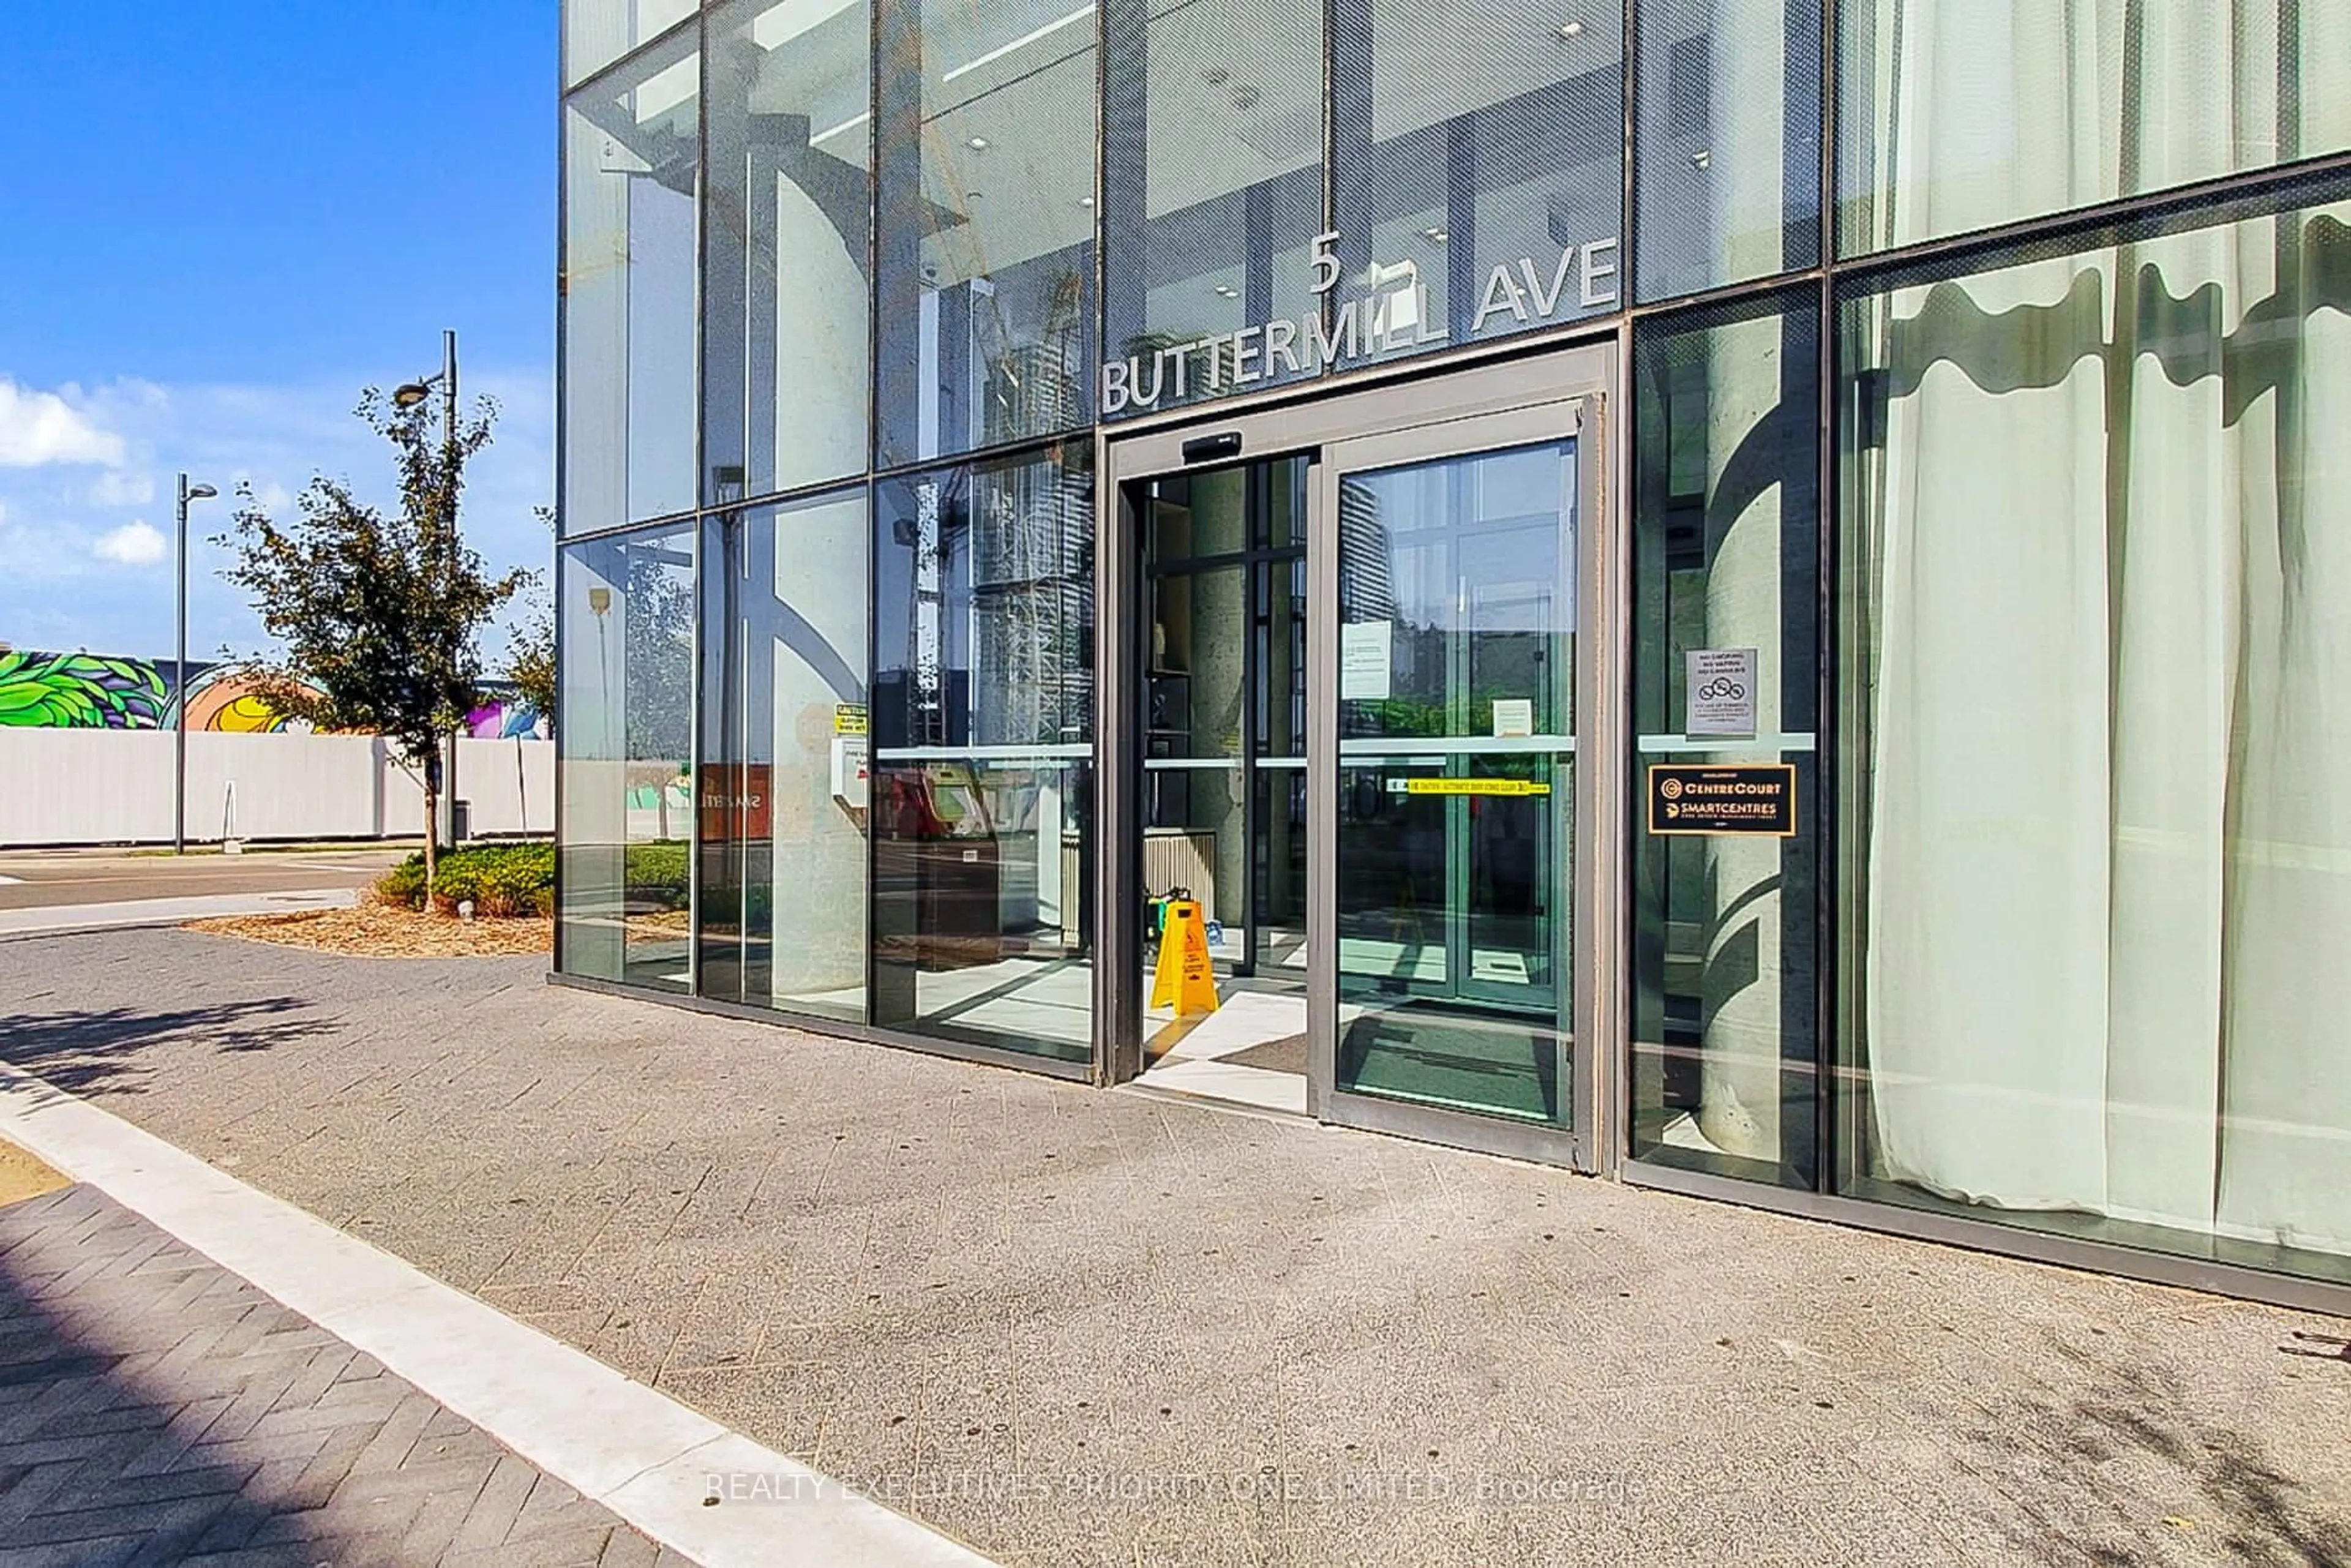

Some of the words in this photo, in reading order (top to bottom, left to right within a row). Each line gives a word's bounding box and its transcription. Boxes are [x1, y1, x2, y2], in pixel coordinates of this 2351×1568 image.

[1310, 230, 1341, 295] 5
[1101, 282, 1450, 415] BUTTERMILL
[1471, 236, 1618, 332] AVE
